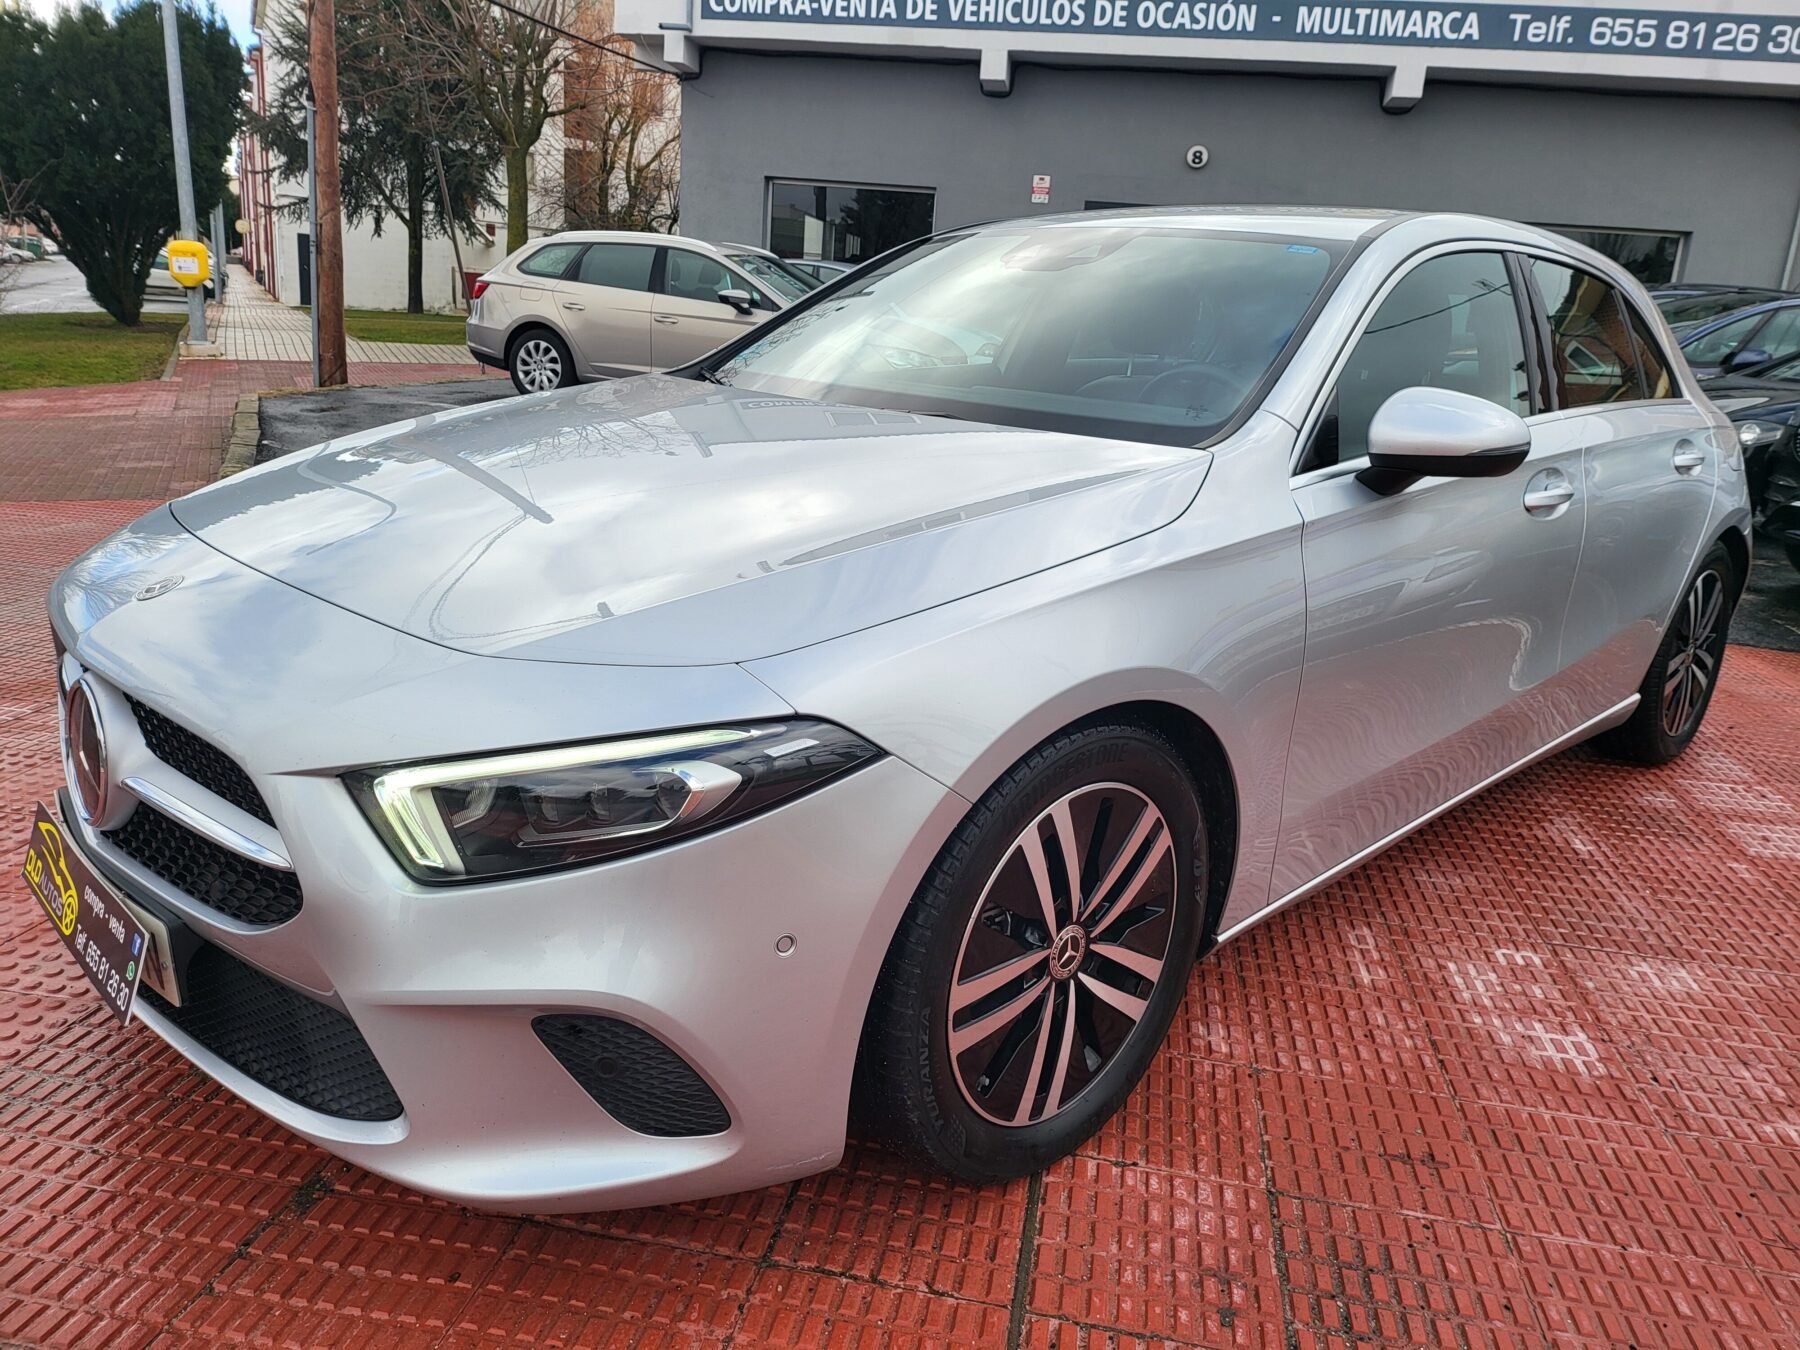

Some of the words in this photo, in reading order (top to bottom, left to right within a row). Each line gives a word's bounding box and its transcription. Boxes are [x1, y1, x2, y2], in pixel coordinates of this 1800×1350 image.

[905, 0, 938, 21] DE
[1093, 1, 1129, 28] DE
[1136, 0, 1257, 32] OCASIÓN
[1296, 6, 1480, 41] MULTIMARCA
[1509, 13, 1573, 44] Telf.
[1589, 16, 1658, 48] 655
[1192, 150, 1203, 165] 8
[84, 885, 105, 919] compra
[109, 914, 126, 944] venta
[75, 923, 88, 956] Telf.
[86, 940, 101, 972] 655
[98, 957, 110, 984] 81
[107, 969, 120, 998] 26
[117, 982, 129, 1011] 30
[919, 1006, 944, 1137] TURANZA
